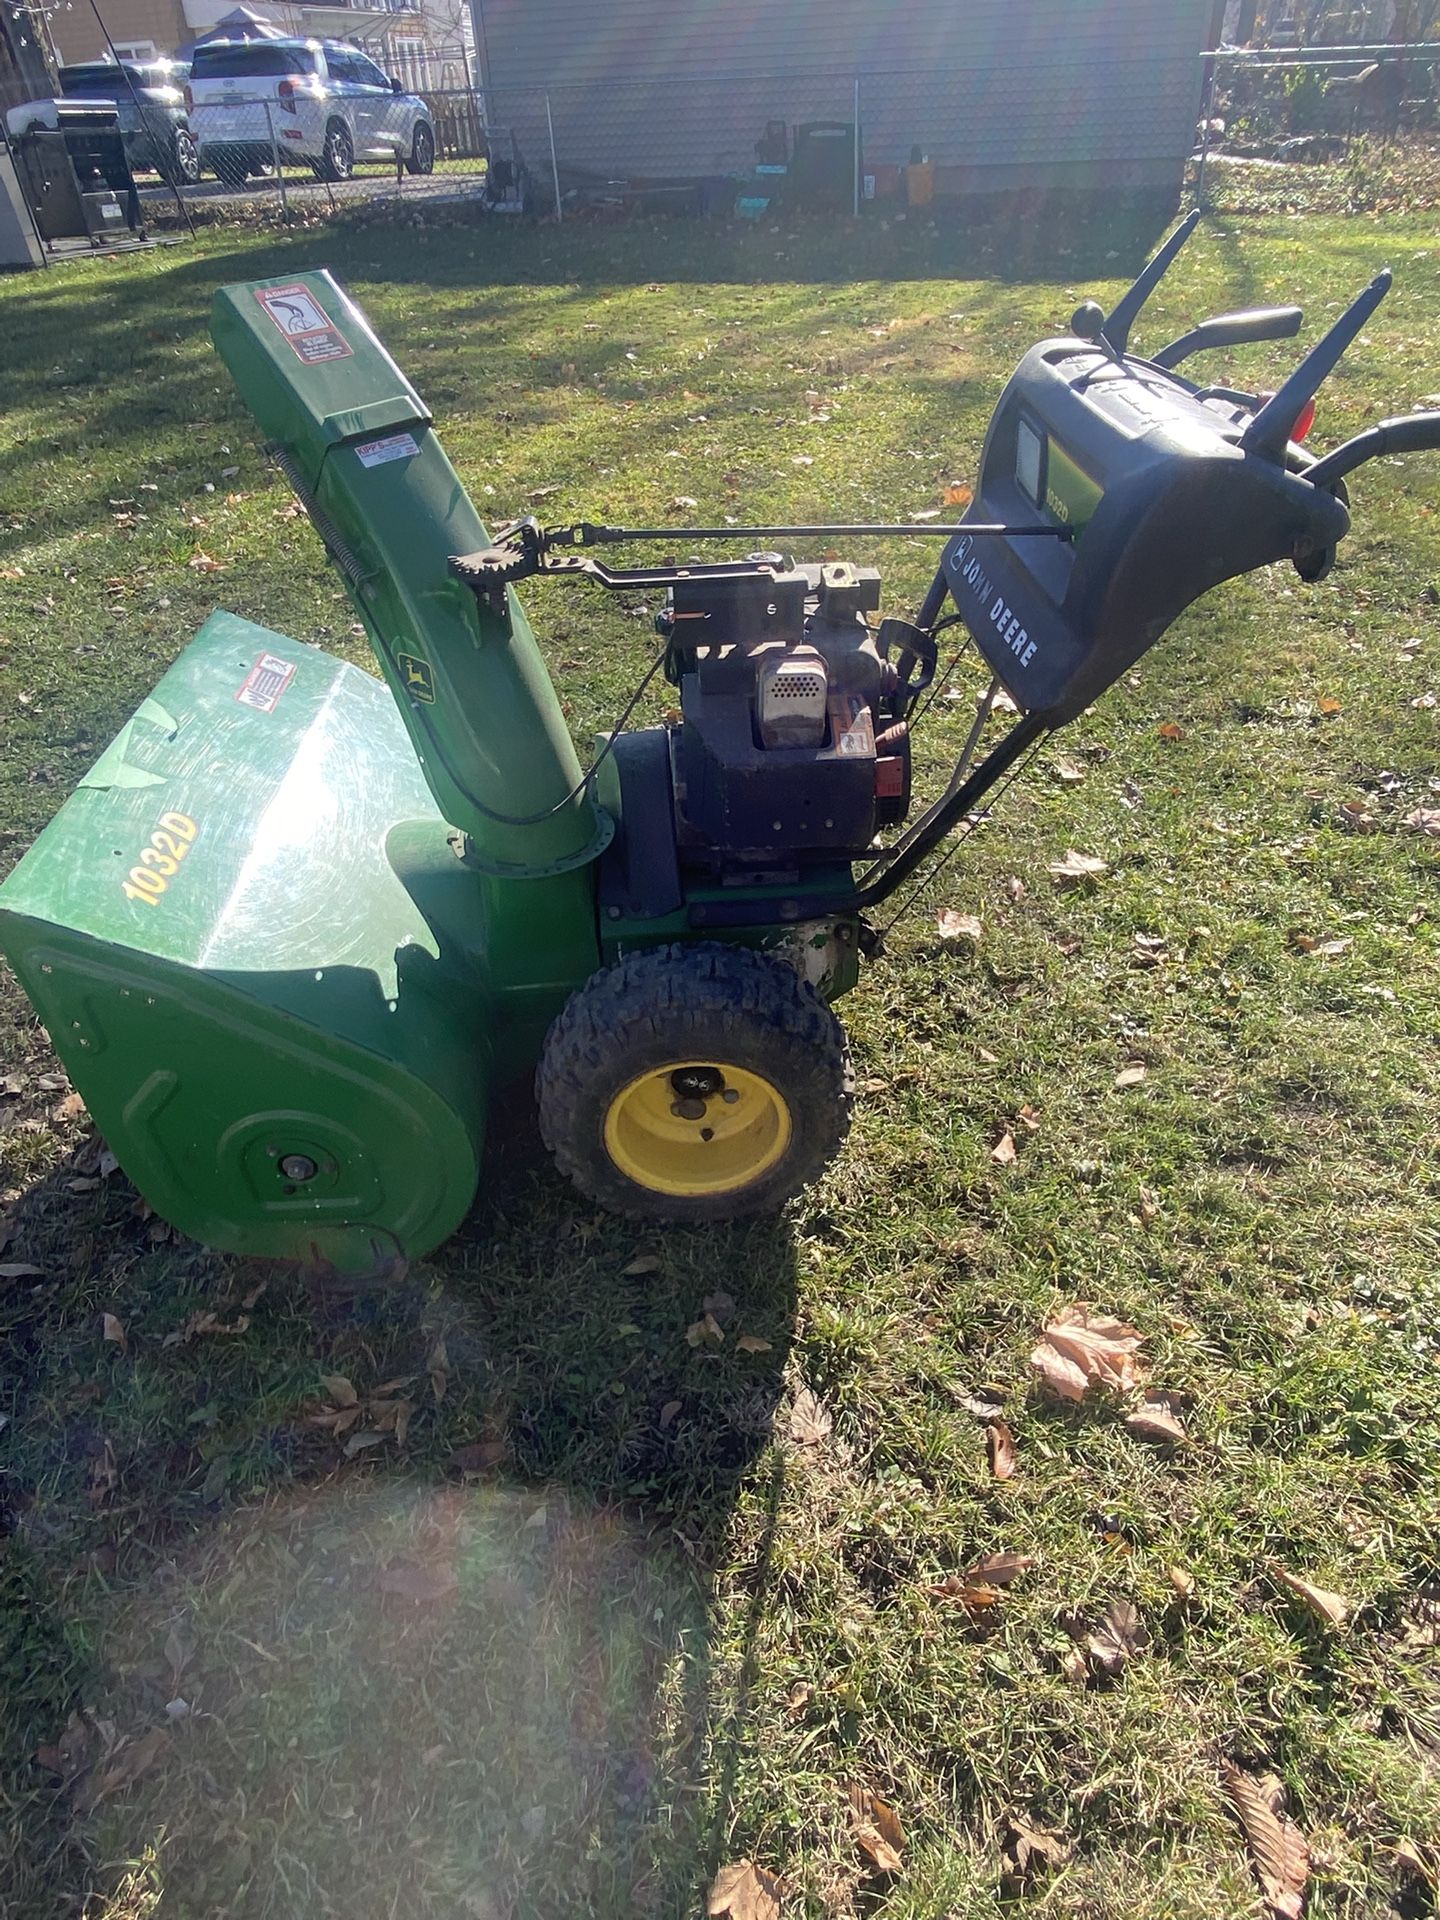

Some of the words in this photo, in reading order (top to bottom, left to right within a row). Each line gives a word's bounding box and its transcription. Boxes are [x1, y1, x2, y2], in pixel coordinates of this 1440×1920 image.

[272, 287, 301, 298] DANGER
[356, 440, 385, 456] KIPP'S
[963, 557, 993, 604] JOHN
[989, 597, 1038, 668] DEERE
[121, 811, 197, 906] 1032D
